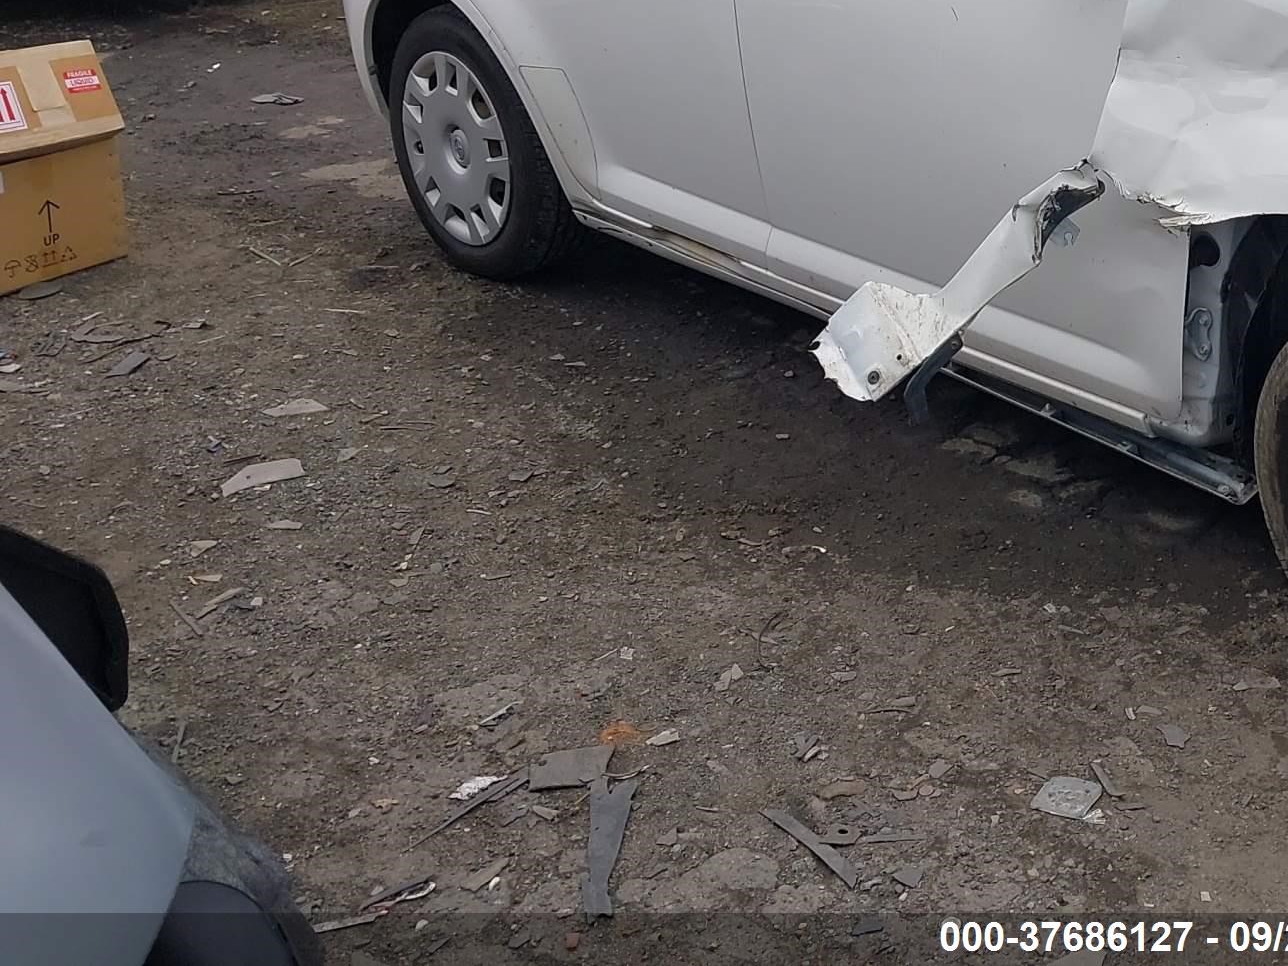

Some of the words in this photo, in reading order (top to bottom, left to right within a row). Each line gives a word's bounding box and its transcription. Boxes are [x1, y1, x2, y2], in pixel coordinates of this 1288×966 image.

[66, 69, 93, 78] FRAGILE
[69, 77, 95, 87] LIQUID
[43, 233, 60, 247] UP
